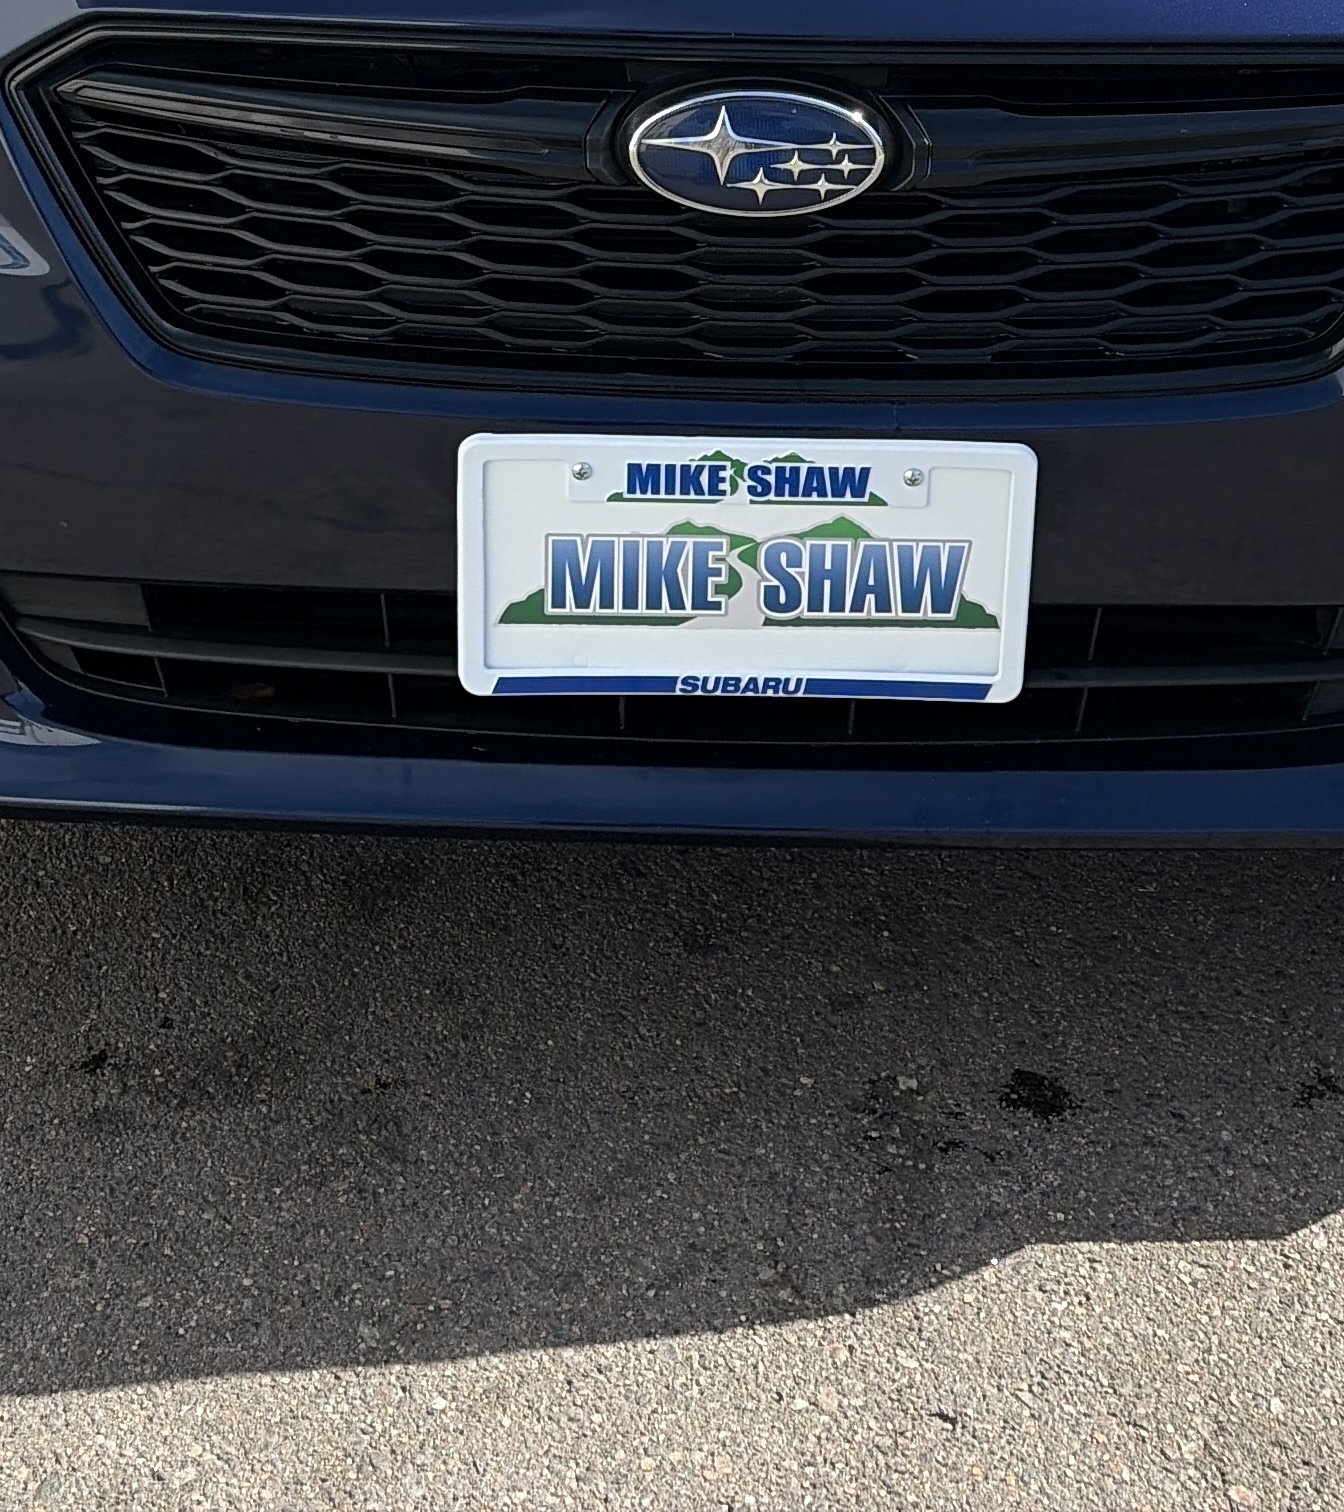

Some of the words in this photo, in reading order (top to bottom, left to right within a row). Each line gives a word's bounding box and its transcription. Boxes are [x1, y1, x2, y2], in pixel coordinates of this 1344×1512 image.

[625, 462, 728, 497] MIKE
[745, 464, 872, 500] SHAW
[547, 536, 728, 614] MIKE
[760, 538, 972, 617] SHAW
[677, 675, 805, 696] SUBARU
